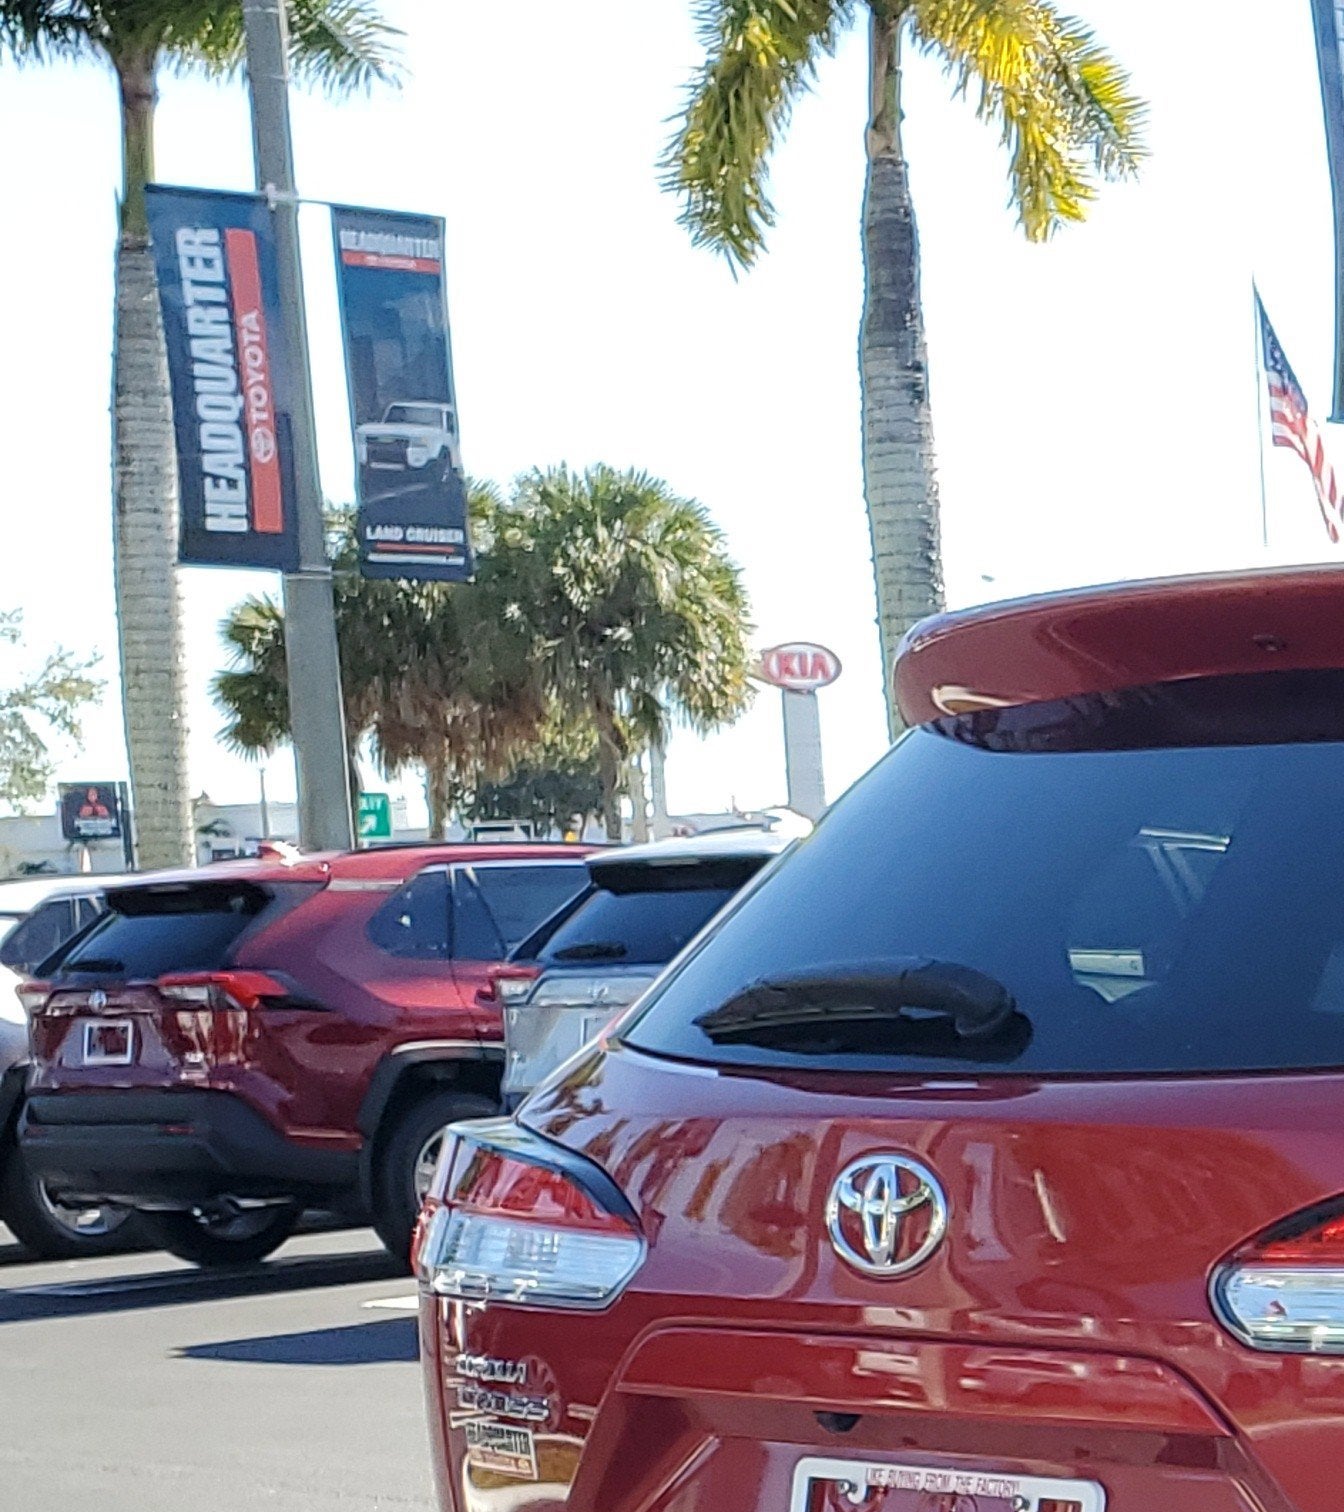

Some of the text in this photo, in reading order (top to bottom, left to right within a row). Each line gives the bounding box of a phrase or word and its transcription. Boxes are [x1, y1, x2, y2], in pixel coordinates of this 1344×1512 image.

[176, 227, 249, 533] HEADQUARTER
[241, 309, 268, 425] TOYOTA
[365, 524, 464, 545] LAND CRUISER
[777, 651, 830, 680] KIA
